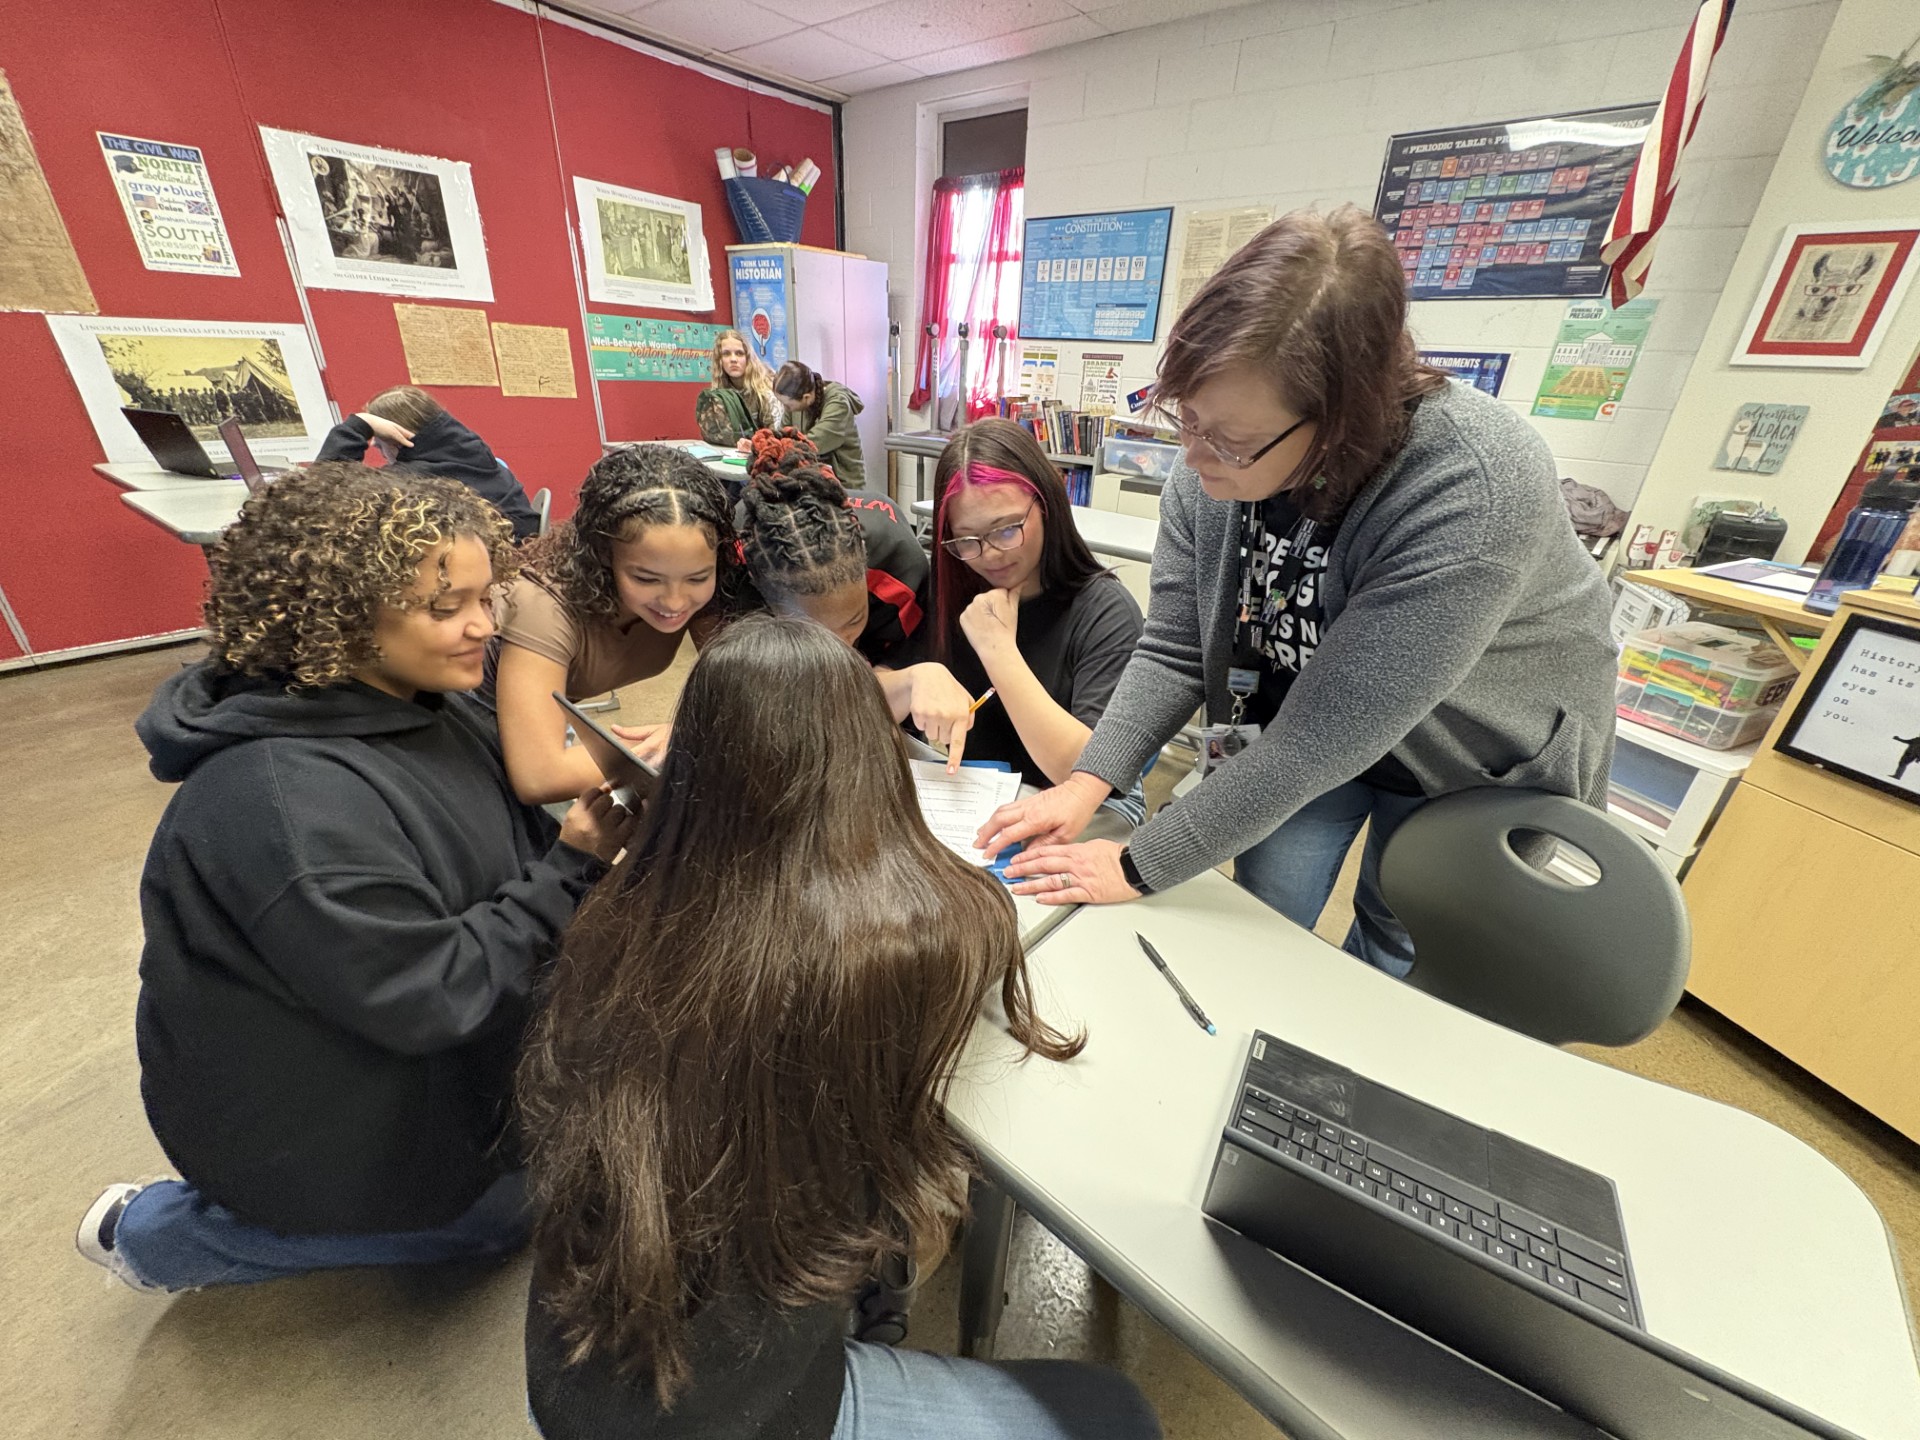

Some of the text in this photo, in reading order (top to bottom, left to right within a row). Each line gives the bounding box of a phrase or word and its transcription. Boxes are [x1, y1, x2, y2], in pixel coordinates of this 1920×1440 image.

[104, 137, 199, 161] THE CIVIL WAR
[1408, 141, 1453, 154] PERIODIC
[1455, 138, 1487, 149] TABLE
[331, 147, 362, 159] ORIGINS
[135, 156, 195, 174] NORTH
[142, 169, 199, 186] abolitionists
[128, 182, 203, 198] gray blue
[158, 203, 183, 213] Union
[1064, 220, 1123, 234] CONSTITUTION
[144, 224, 217, 244] SOUTH
[148, 240, 200, 250] secession
[211, 217, 230, 265] Proclamation
[153, 249, 203, 263] slavery
[740, 259, 776, 268] THINK LIKE A
[735, 267, 782, 280] HISTORIAN
[79, 323, 121, 331] LINCOLN
[159, 326, 202, 335] GENERALS
[592, 335, 677, 350] Well-Behaved Women
[629, 346, 667, 359] Seldom
[1427, 356, 1481, 369] AMENDMENTS
[1600, 403, 1616, 416] C
[1748, 423, 1797, 441] ALPACA
[1767, 442, 1787, 454] my
[1860, 648, 1920, 674] History
[1850, 664, 1916, 688] has its
[1841, 681, 1878, 695] eyes
[1832, 696, 1849, 706] on
[1822, 710, 1855, 725] you.
[1372, 1168, 1381, 1176] m
[1385, 1192, 1391, 1200] j
[1425, 1193, 1432, 1202] b
[1411, 1205, 1418, 1214] h
[1496, 1246, 1503, 1254] d
